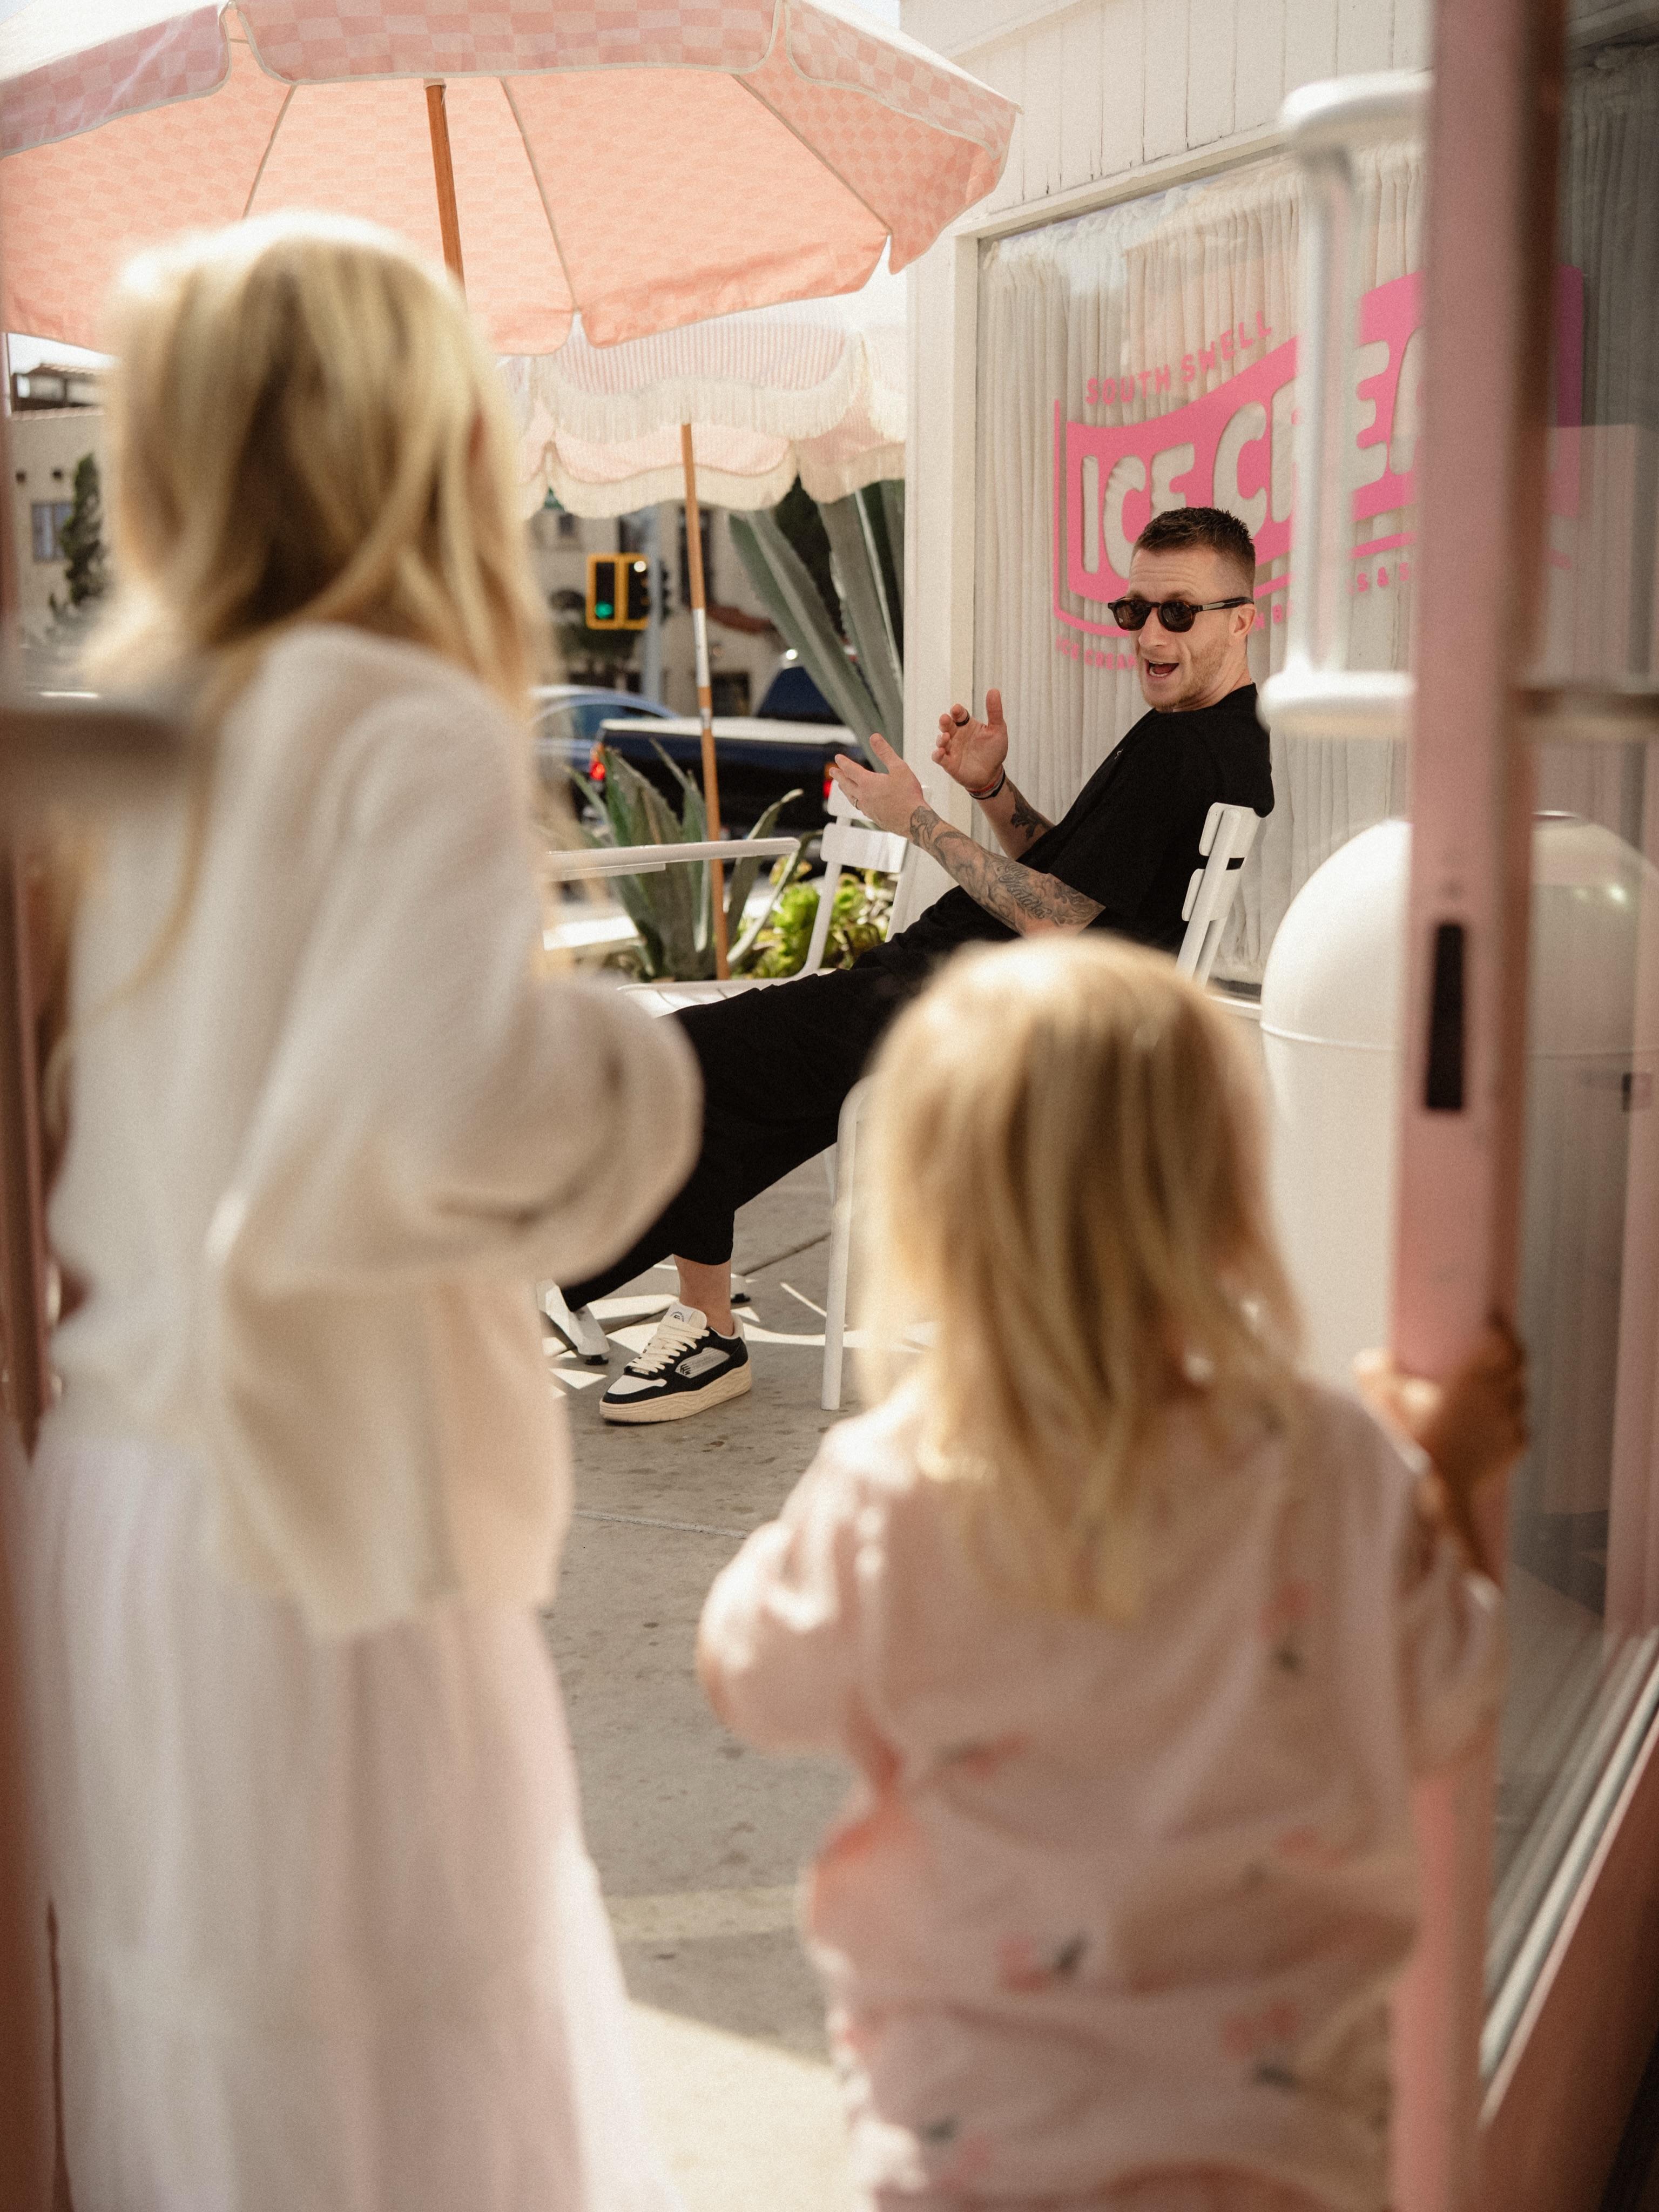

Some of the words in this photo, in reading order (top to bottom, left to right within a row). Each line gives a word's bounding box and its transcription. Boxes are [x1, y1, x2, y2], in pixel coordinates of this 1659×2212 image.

[1085, 363, 1171, 406] SOUTH
[1181, 311, 1272, 383] SWELL
[1055, 633, 1080, 662] ICE
